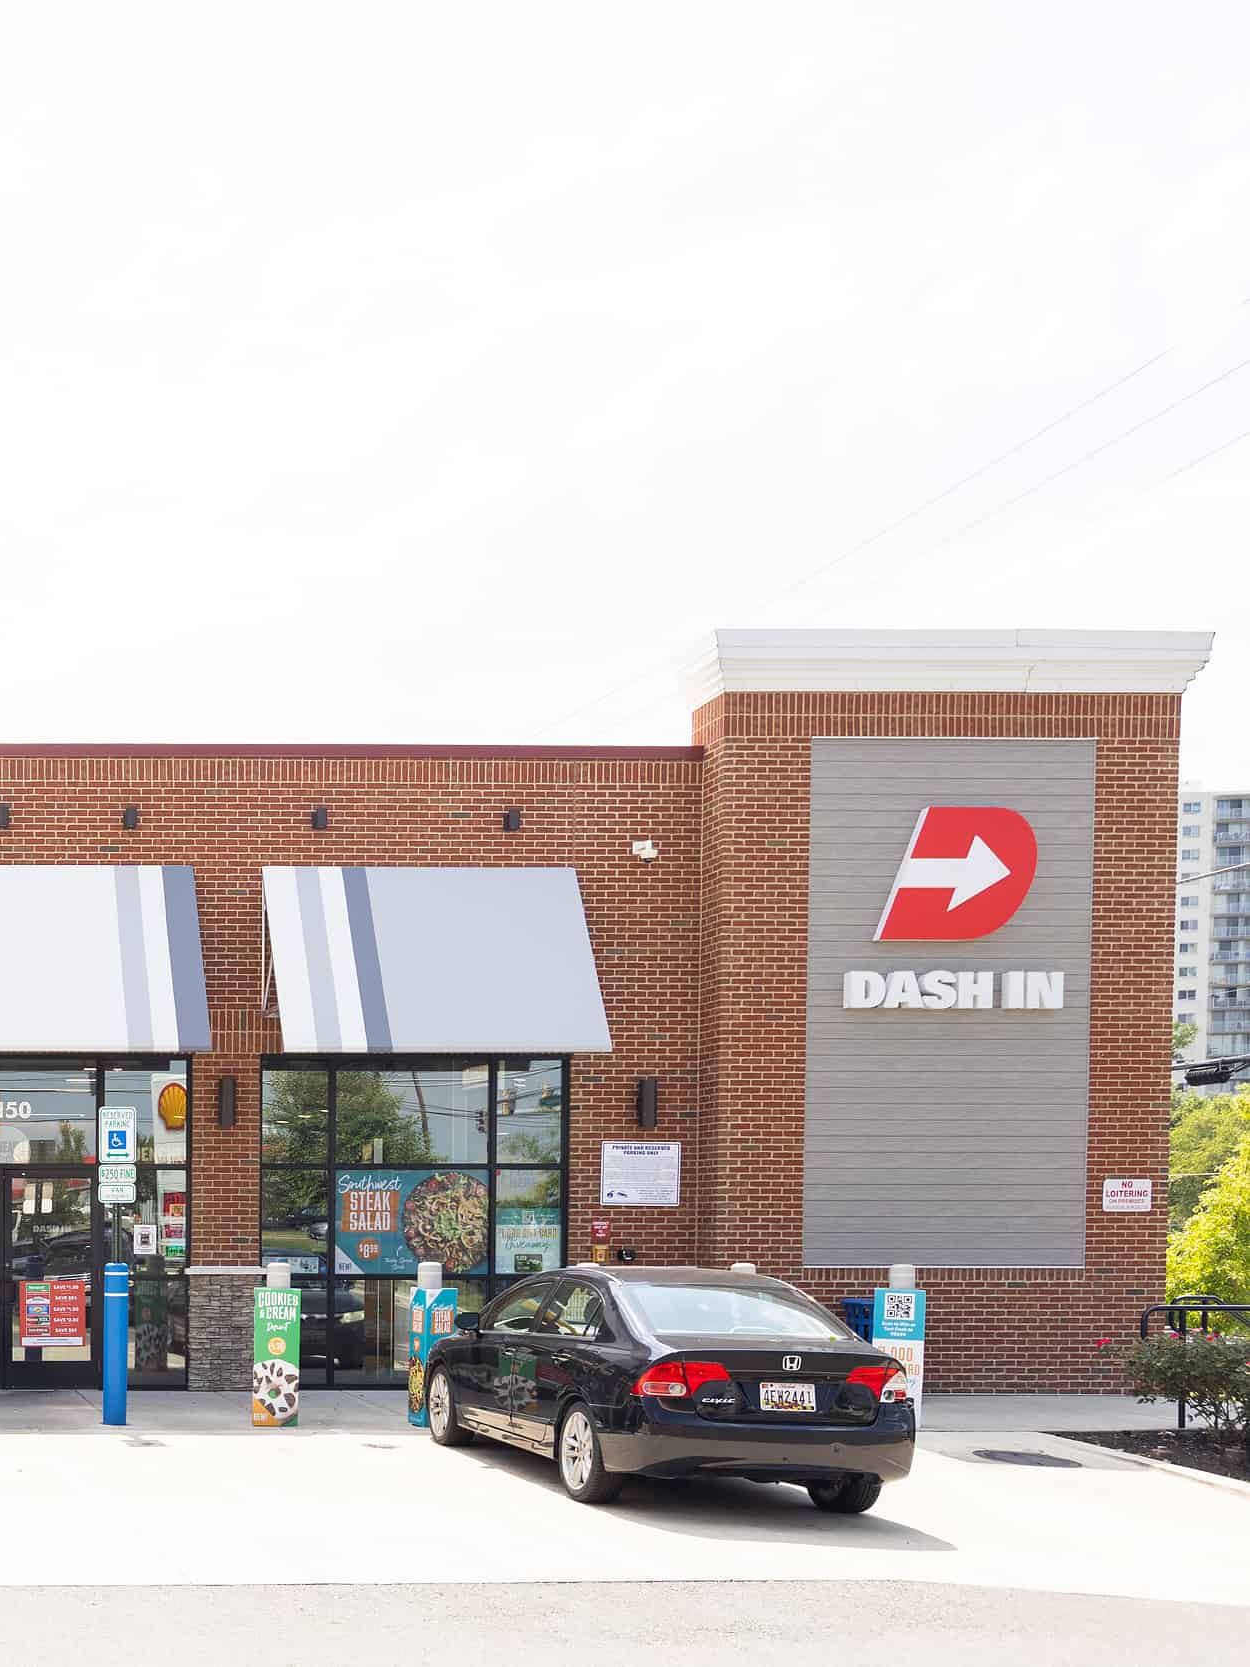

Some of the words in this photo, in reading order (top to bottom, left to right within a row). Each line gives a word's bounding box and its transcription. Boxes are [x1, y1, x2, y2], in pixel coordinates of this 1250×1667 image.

[843, 970, 994, 1009] DASH
[1001, 970, 1065, 1009] IN
[102, 1111, 133, 1120] RESERVED
[105, 1120, 130, 1128] PARKING
[101, 1168, 118, 1179] $250
[120, 1168, 135, 1179] FINE
[338, 1174, 402, 1193] Southwest
[350, 1191, 390, 1211] STEAK
[1106, 1189, 1148, 1198] LOITERING
[350, 1211, 390, 1231] SALAD
[258, 1291, 299, 1308] COOKIES
[266, 1306, 297, 1321] CREAM
